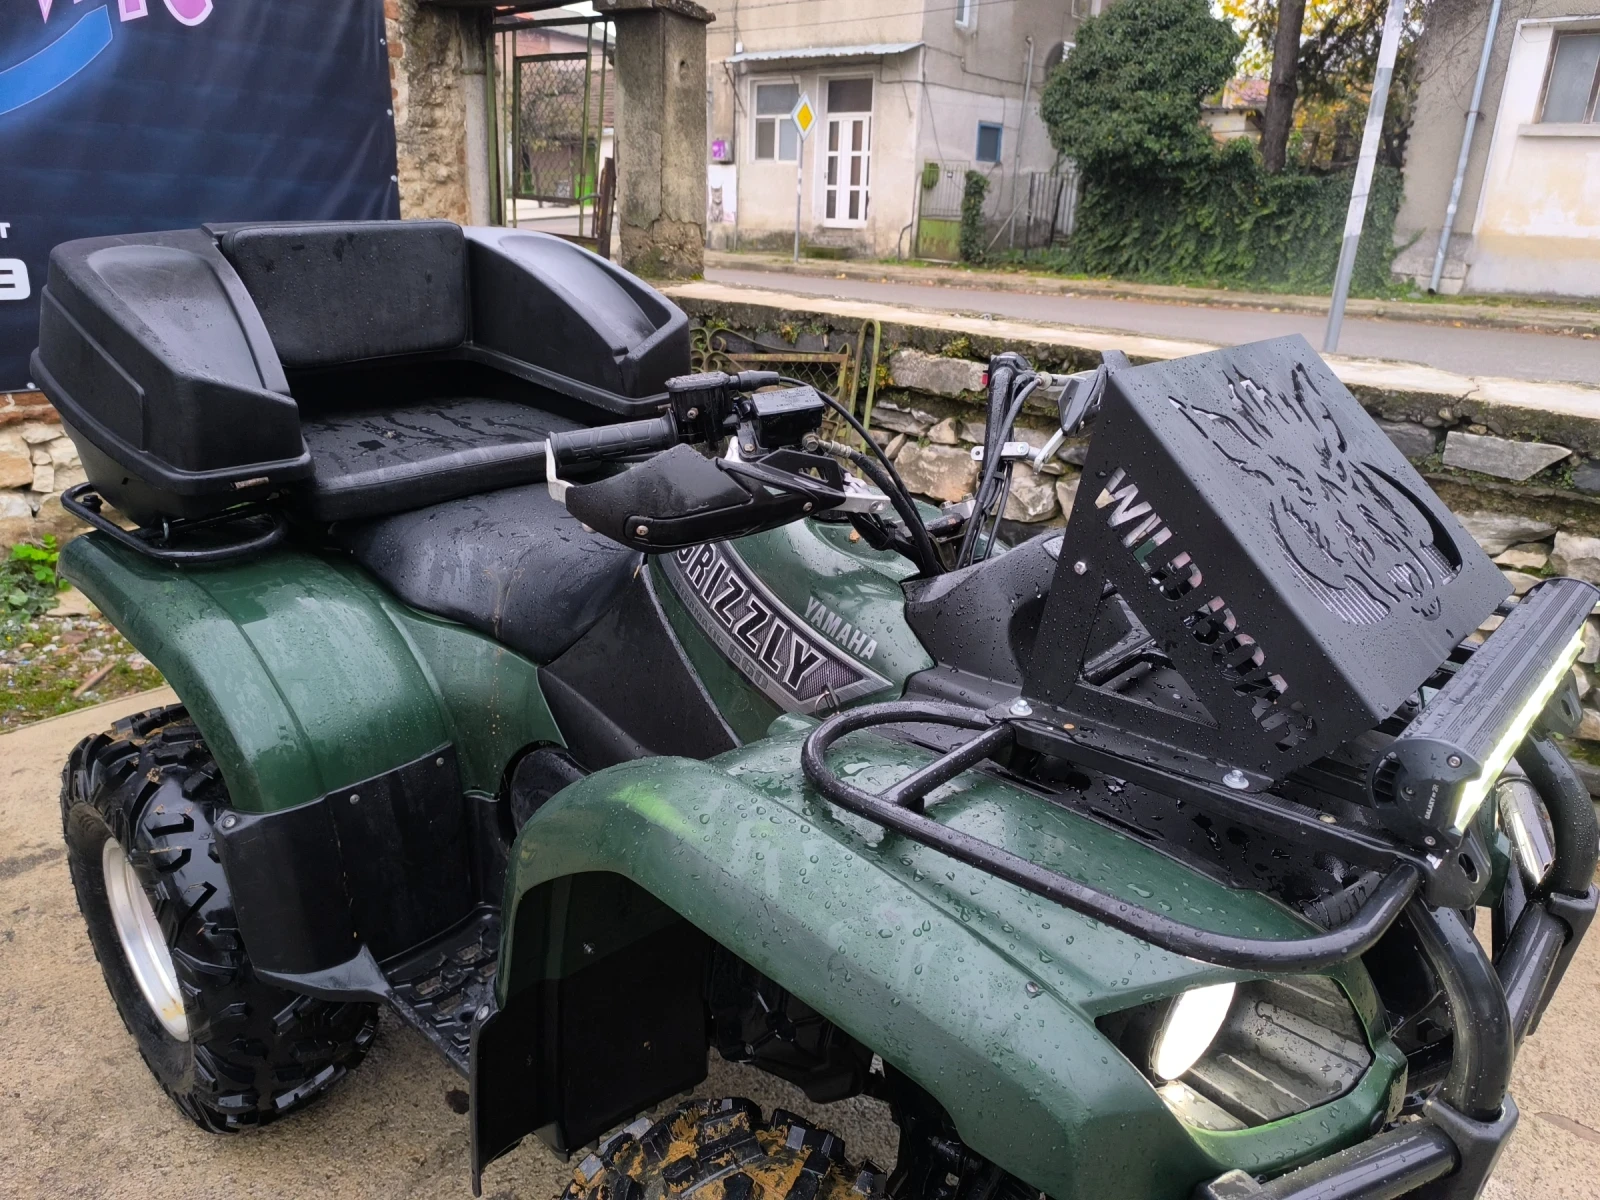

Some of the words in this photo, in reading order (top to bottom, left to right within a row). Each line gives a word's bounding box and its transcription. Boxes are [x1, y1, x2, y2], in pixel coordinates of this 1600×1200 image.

[803, 597, 878, 660] YAMAHA
[1094, 467, 1203, 602] WILD
[1182, 595, 1318, 753] BOAR
[726, 643, 769, 691] 660
[1424, 796, 1436, 820] GALAXY
